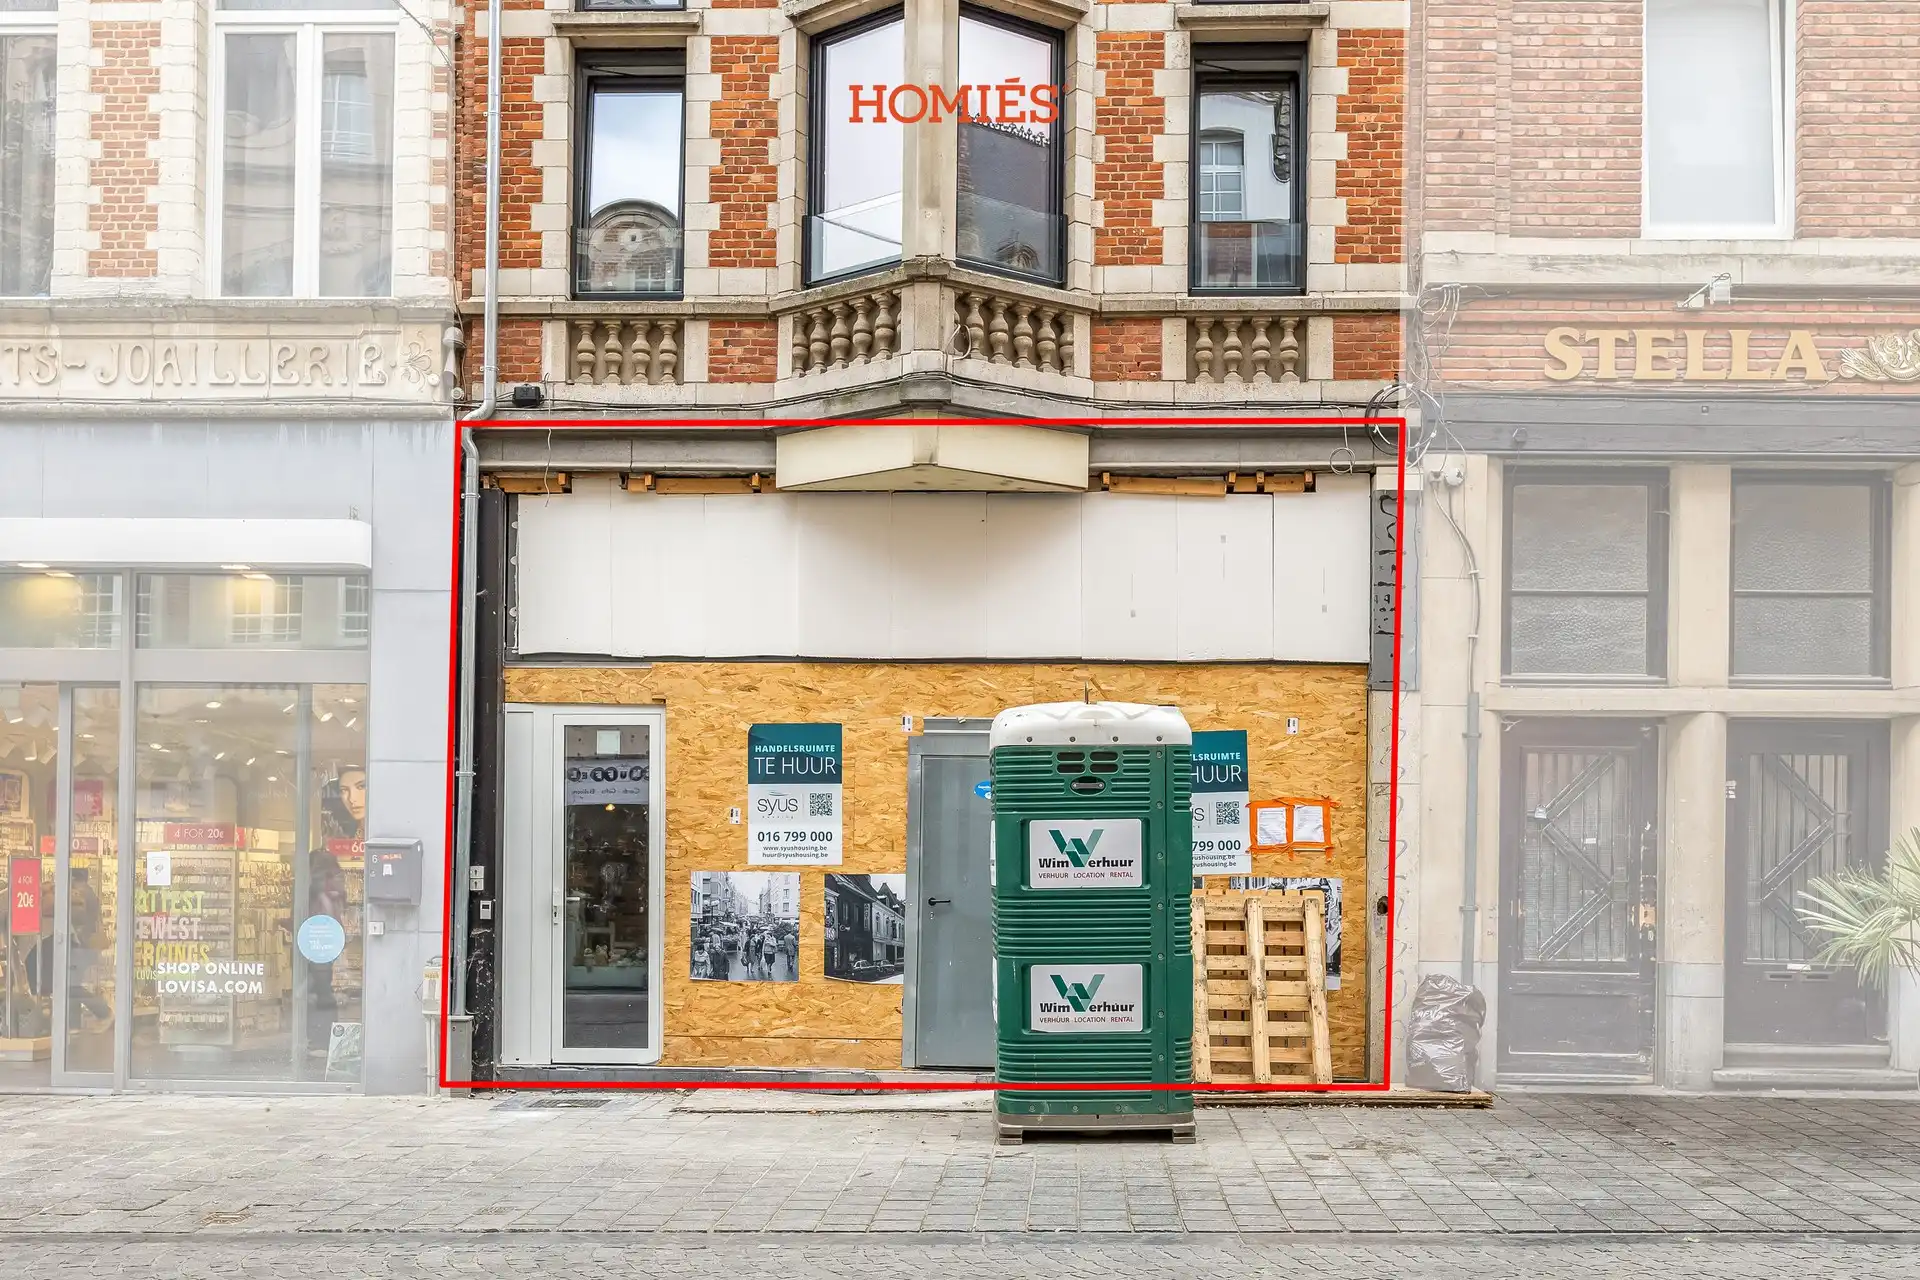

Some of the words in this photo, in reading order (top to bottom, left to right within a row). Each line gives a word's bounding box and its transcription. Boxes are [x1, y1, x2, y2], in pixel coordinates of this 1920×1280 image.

[1544, 327, 1829, 381] STELLA
[0, 343, 389, 386] TS-JOAILLERIE
[754, 744, 836, 753] HANDELSRUIMTE
[1191, 752, 1241, 762] LSRUIMTE
[753, 757, 776, 775] TE
[782, 757, 836, 775] HUUR
[183, 829, 204, 839] FOR
[757, 831, 780, 842] 016
[783, 831, 807, 842] 799
[810, 831, 833, 842] 000
[763, 845, 828, 853] www.syushousing.be
[1217, 839, 1241, 851] 000
[762, 851, 829, 860] huur@syushousing.be
[1192, 854, 1236, 862] ushousing.be
[1038, 857, 1069, 868] Wim
[1192, 860, 1237, 869] yushousing.be
[17, 892, 34, 908] 20€
[136, 969, 157, 980] LOVIS
[157, 962, 201, 975] SHOP
[205, 962, 264, 976] ONLINE
[157, 980, 263, 994] LOVISA.COM
[1040, 1002, 1070, 1013] Wim
